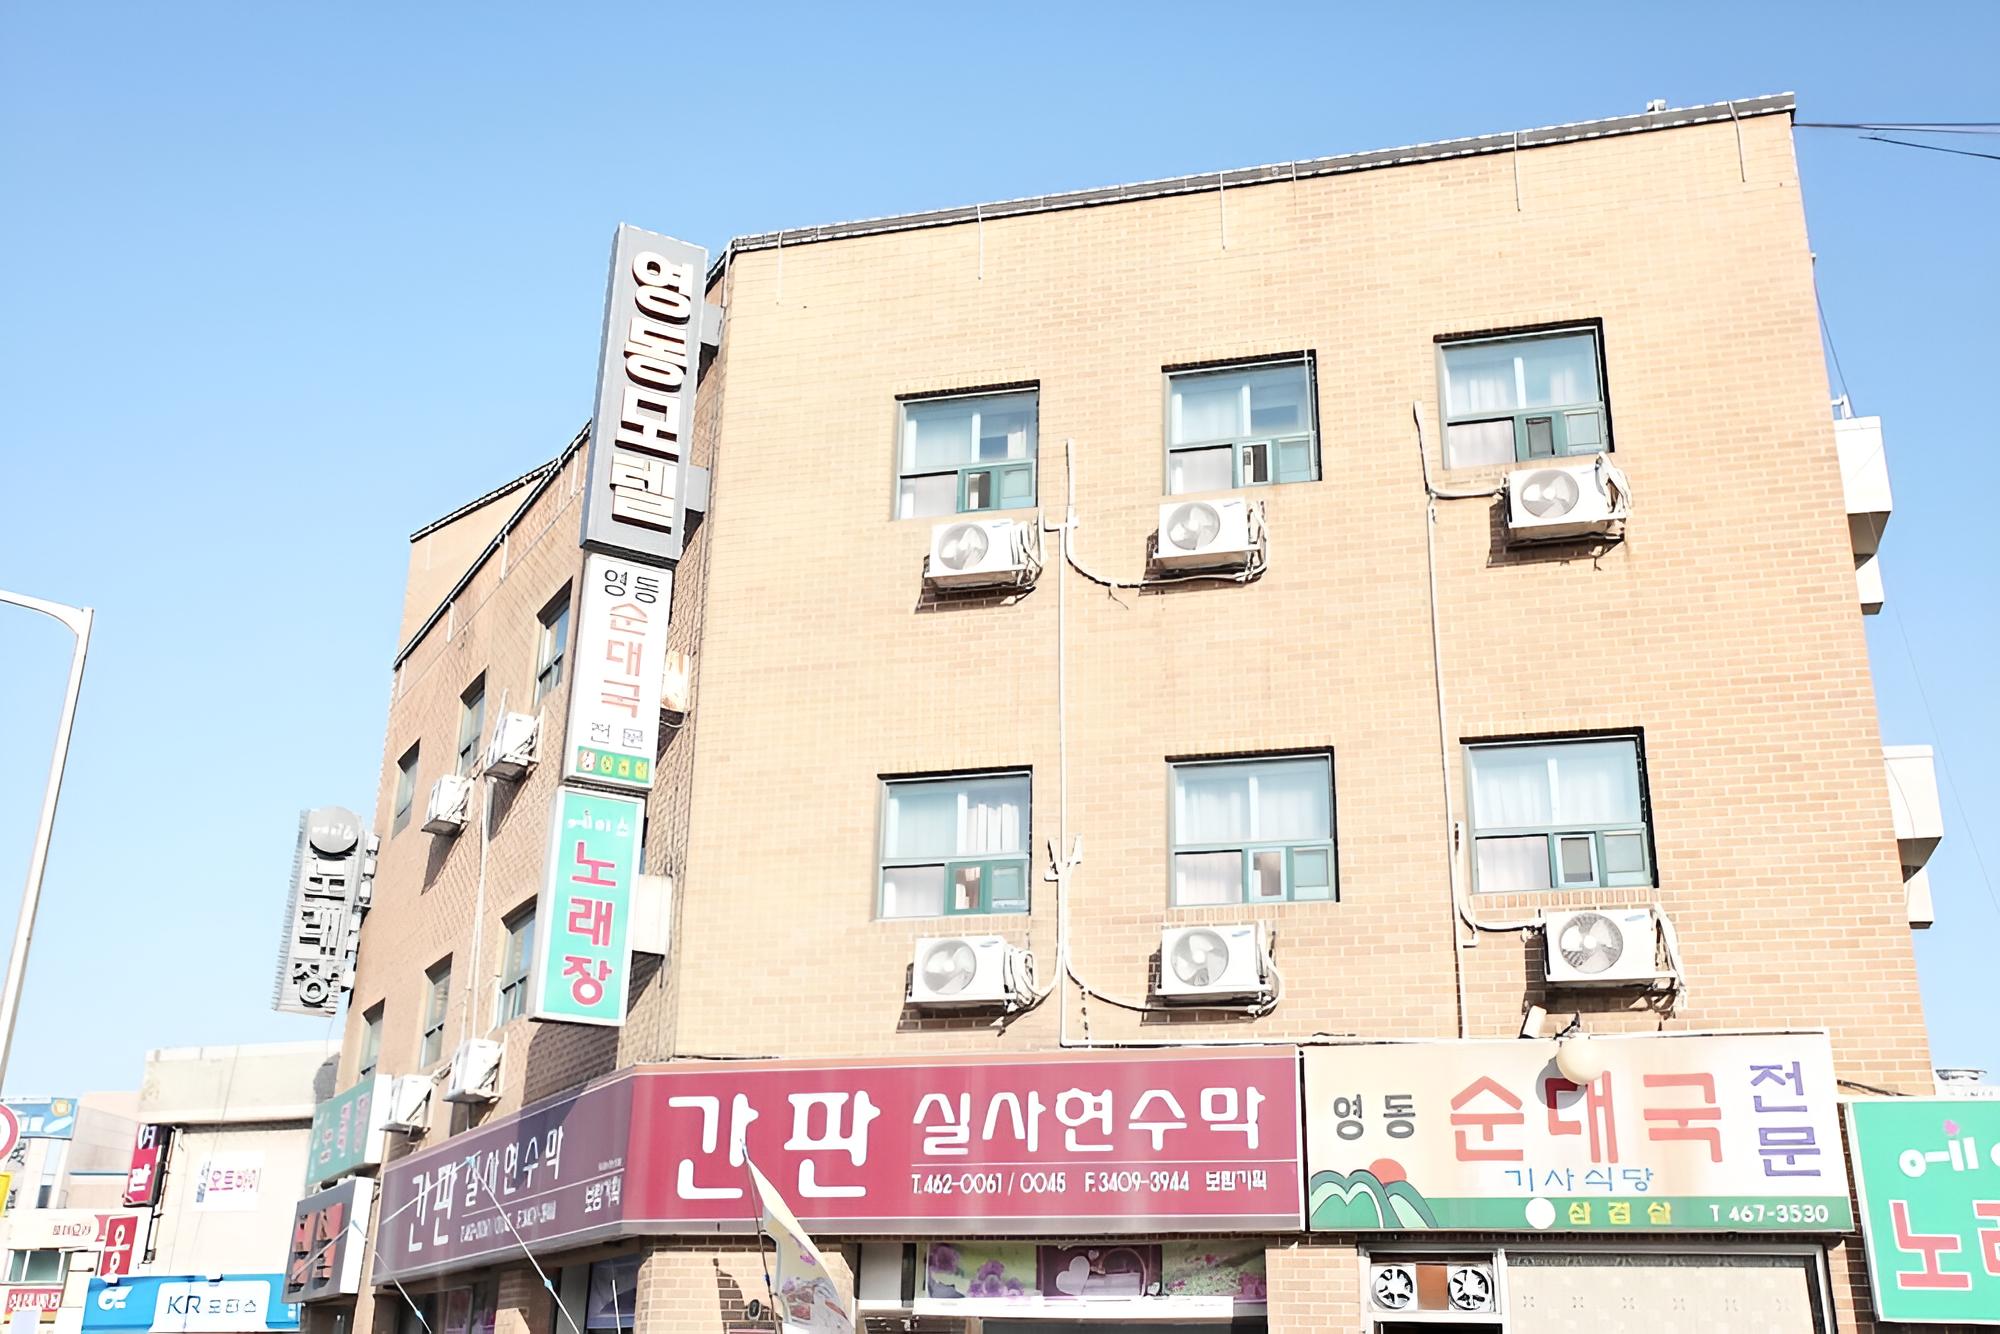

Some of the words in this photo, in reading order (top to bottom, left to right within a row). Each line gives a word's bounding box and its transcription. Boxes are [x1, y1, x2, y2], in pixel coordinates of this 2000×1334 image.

[604, 569, 660, 604] 영동
[601, 602, 648, 718] 순대국
[563, 840, 617, 1006] 노래장
[668, 1091, 881, 1200] 간판
[1333, 1093, 1416, 1141] 영동
[1449, 1070, 1723, 1163] 순대국
[1749, 1061, 1822, 1177] 전문
[1504, 1167, 1654, 1192] 기사식당
[1898, 1136, 2000, 1178] 에
[1728, 1204, 1830, 1223] 467-3530
